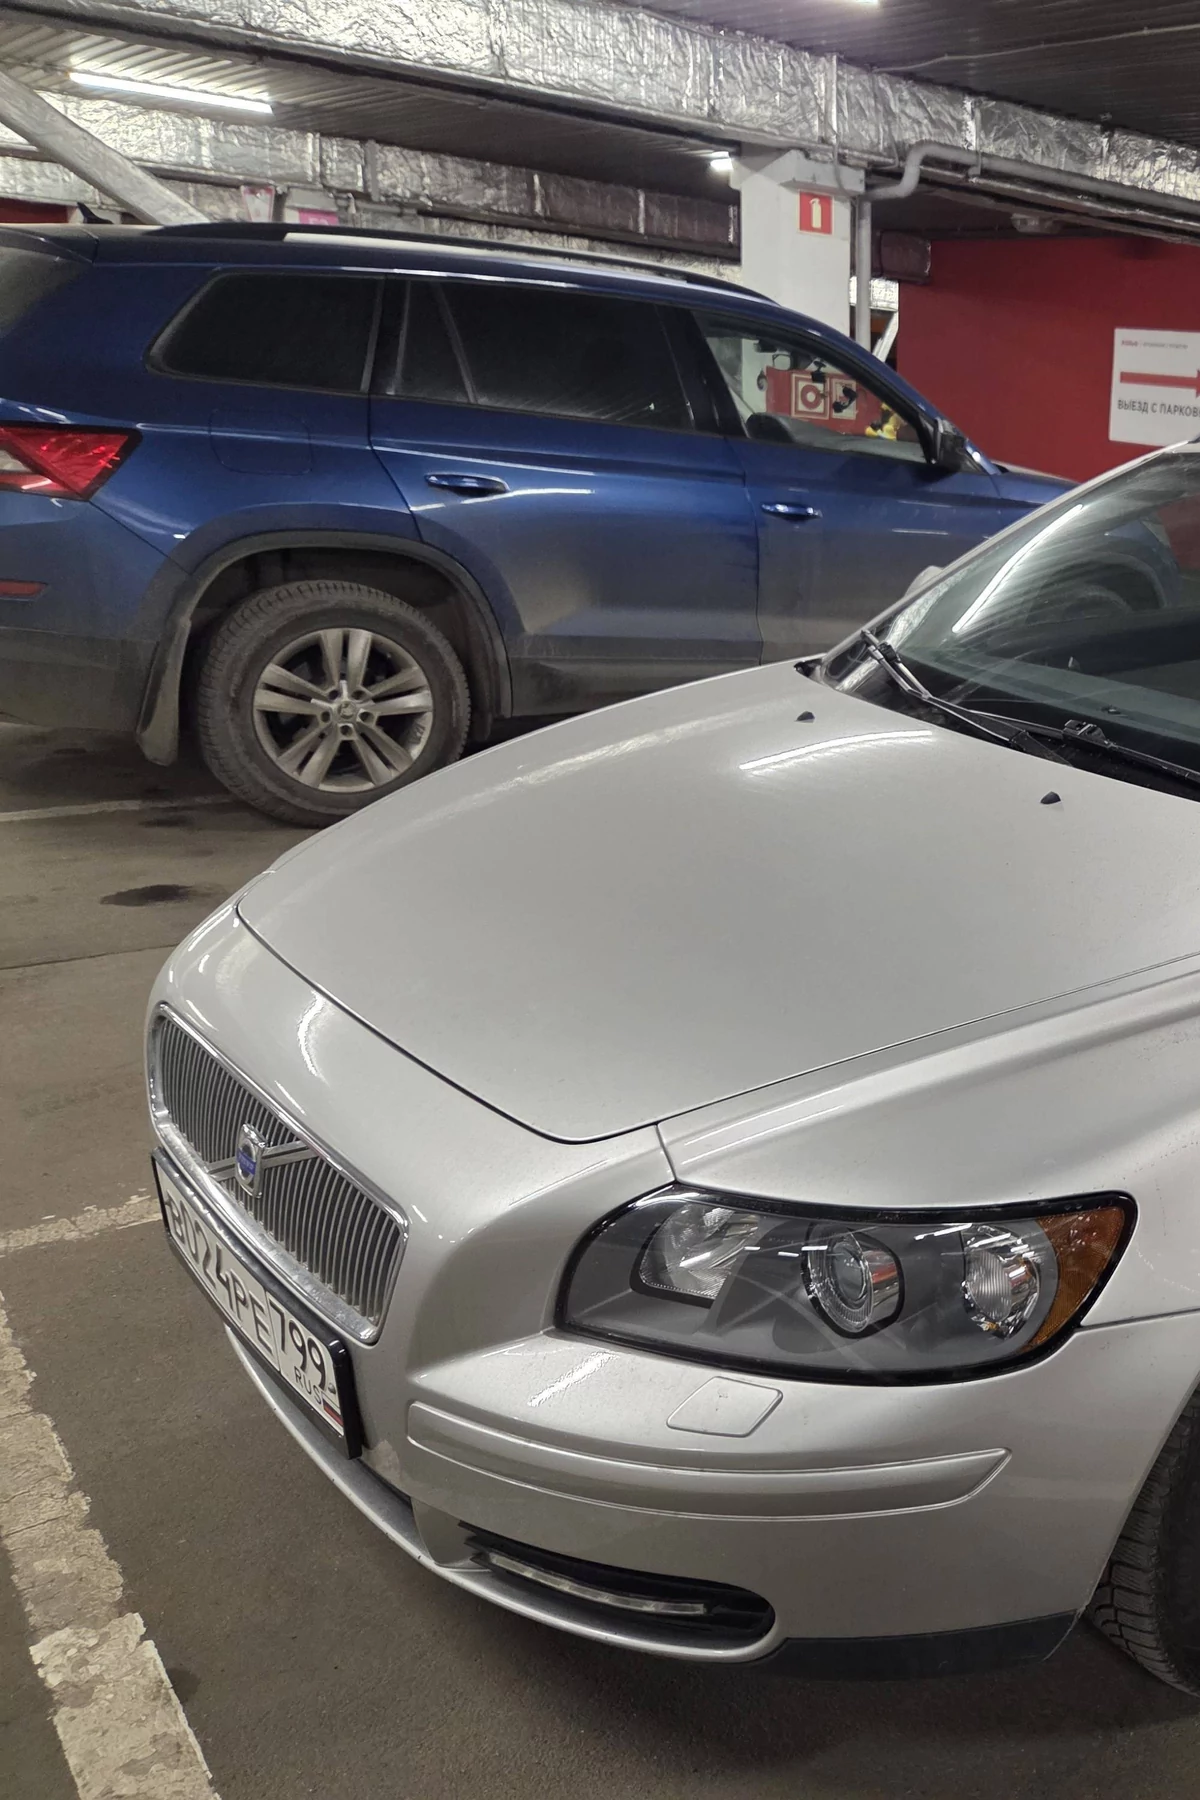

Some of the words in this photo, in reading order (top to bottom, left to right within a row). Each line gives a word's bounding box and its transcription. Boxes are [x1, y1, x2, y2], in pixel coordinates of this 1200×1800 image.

[1117, 399, 1149, 414] ВЫЕЗД
[1151, 402, 1158, 413] С
[269, 1297, 326, 1391] 799
[294, 1365, 323, 1405] RUS
